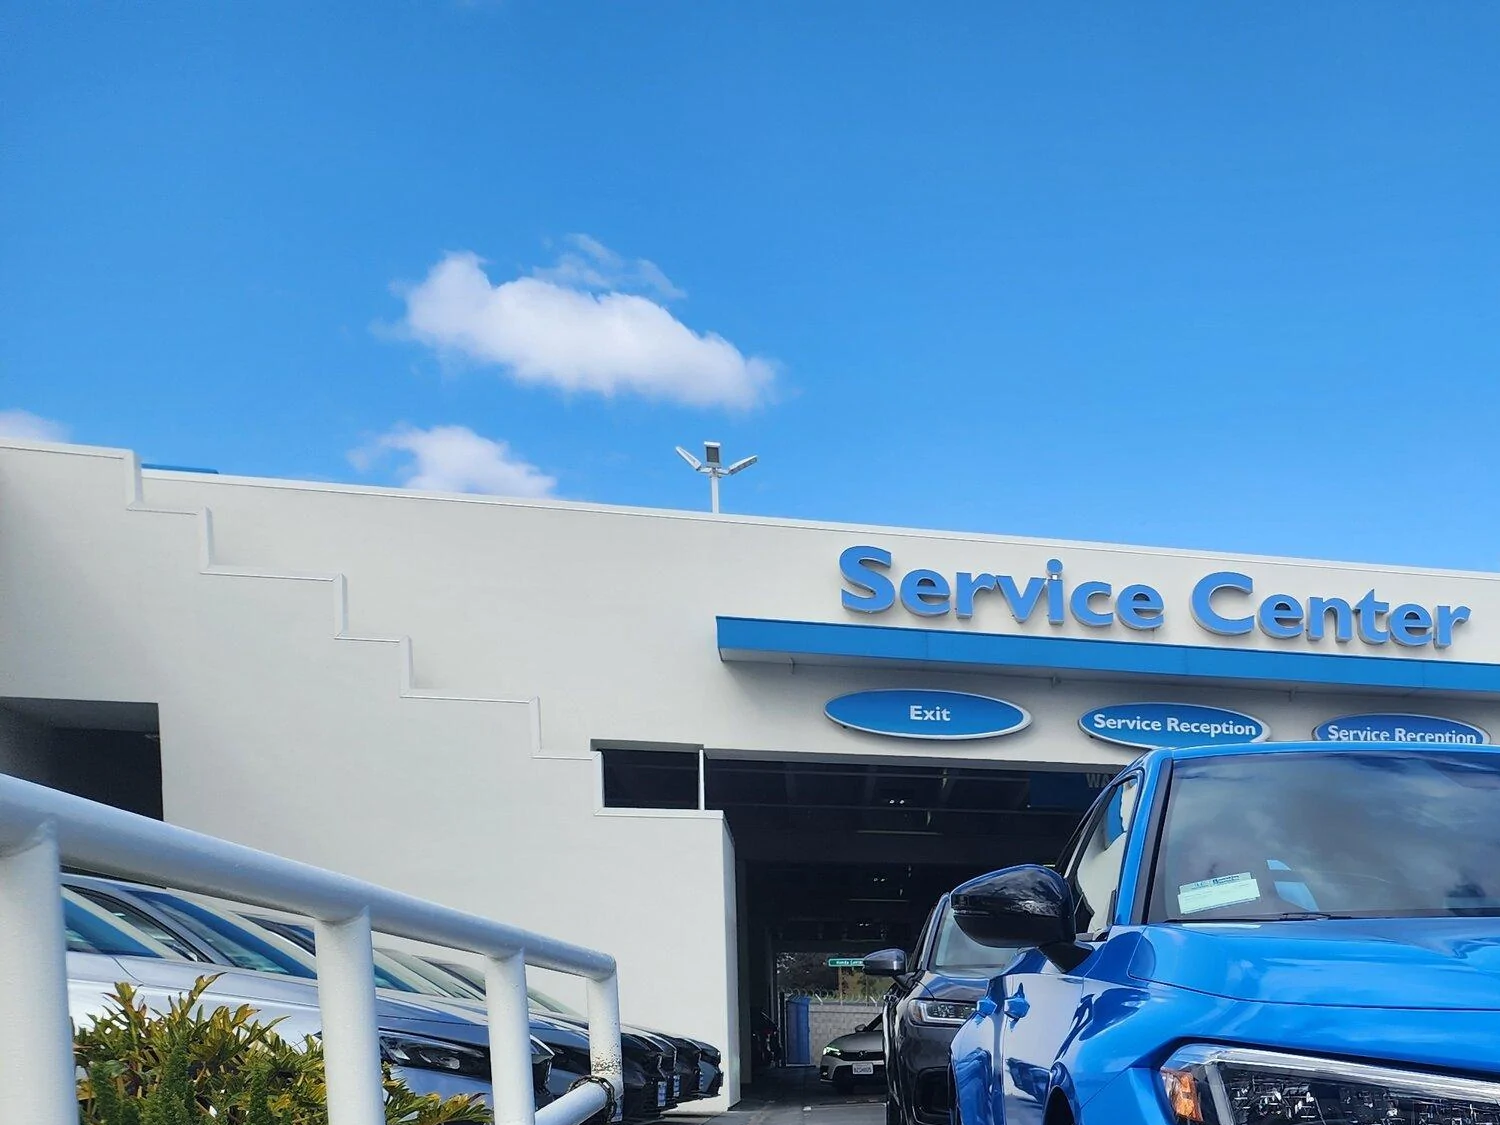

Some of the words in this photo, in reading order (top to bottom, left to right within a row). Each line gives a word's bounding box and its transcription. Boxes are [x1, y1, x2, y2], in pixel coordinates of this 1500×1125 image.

[839, 545, 1165, 631] Service
[1189, 571, 1472, 649] Center
[909, 705, 951, 721] Exit
[1093, 713, 1162, 731] Service
[1166, 717, 1256, 738] Reception
[1328, 725, 1390, 741] Service
